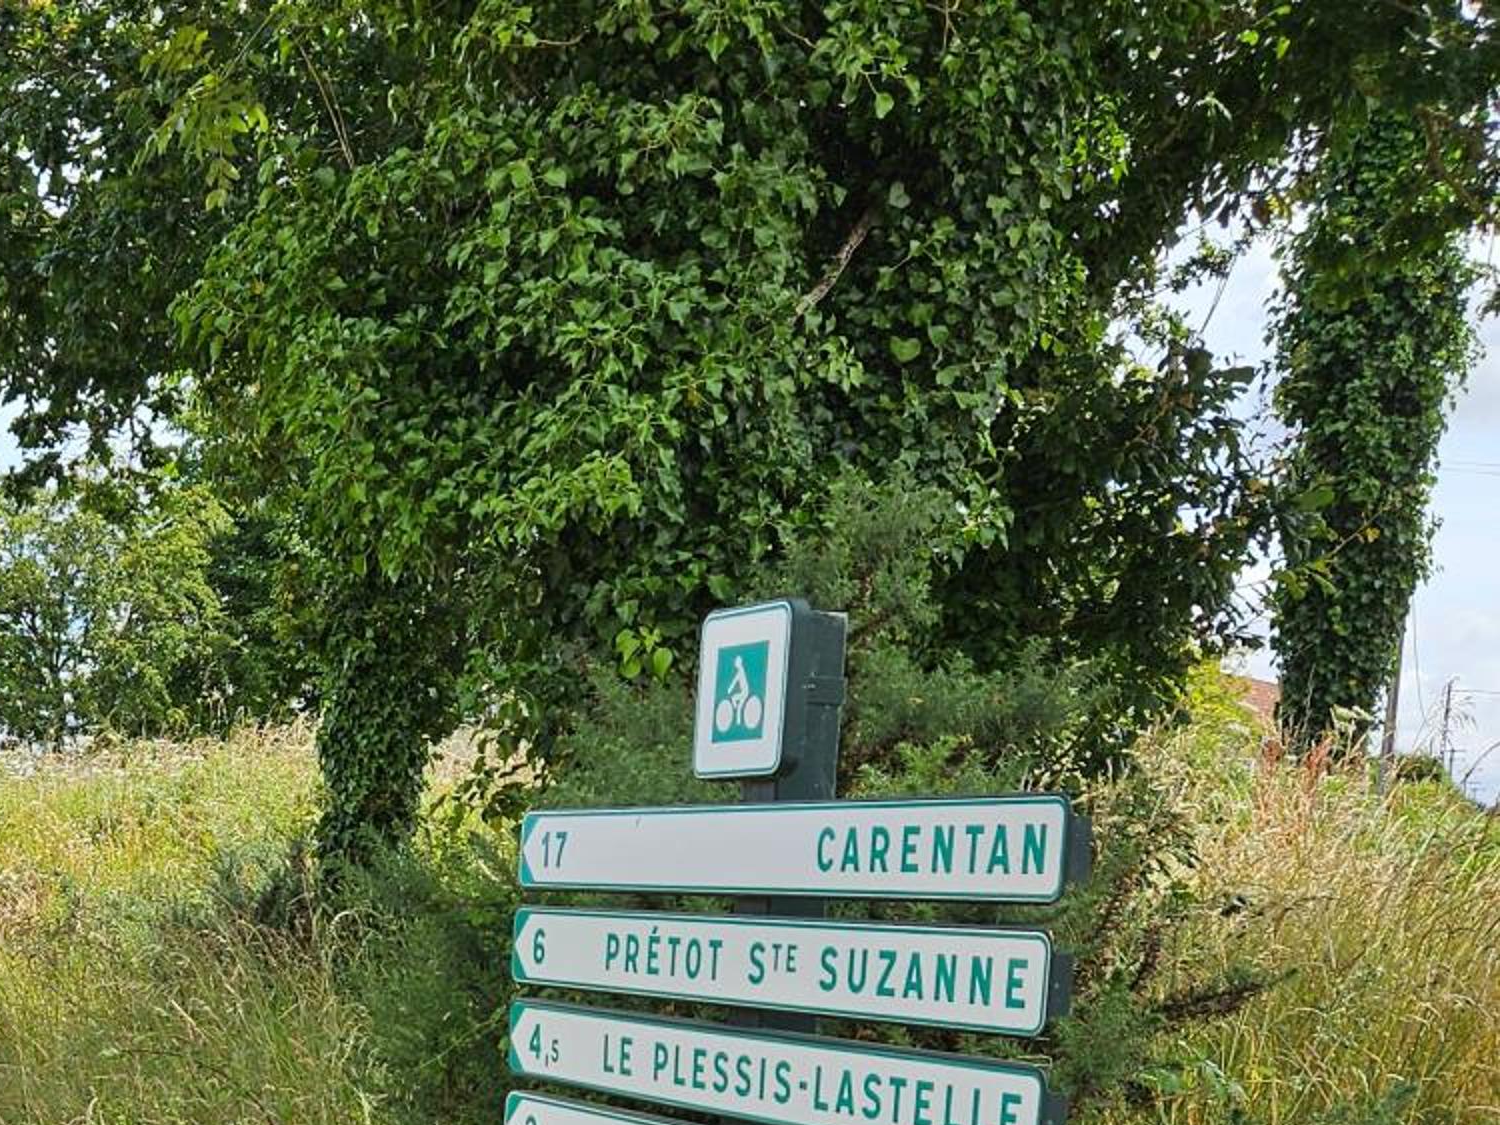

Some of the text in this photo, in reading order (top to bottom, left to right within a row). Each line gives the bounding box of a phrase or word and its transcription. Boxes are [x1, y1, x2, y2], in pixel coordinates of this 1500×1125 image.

[541, 823, 1048, 876] 17 CARENTAN
[532, 927, 546, 966] 6
[605, 926, 724, 981] PRÉTOT
[818, 946, 1029, 1010] SUZANNE
[602, 1033, 634, 1077] LE
